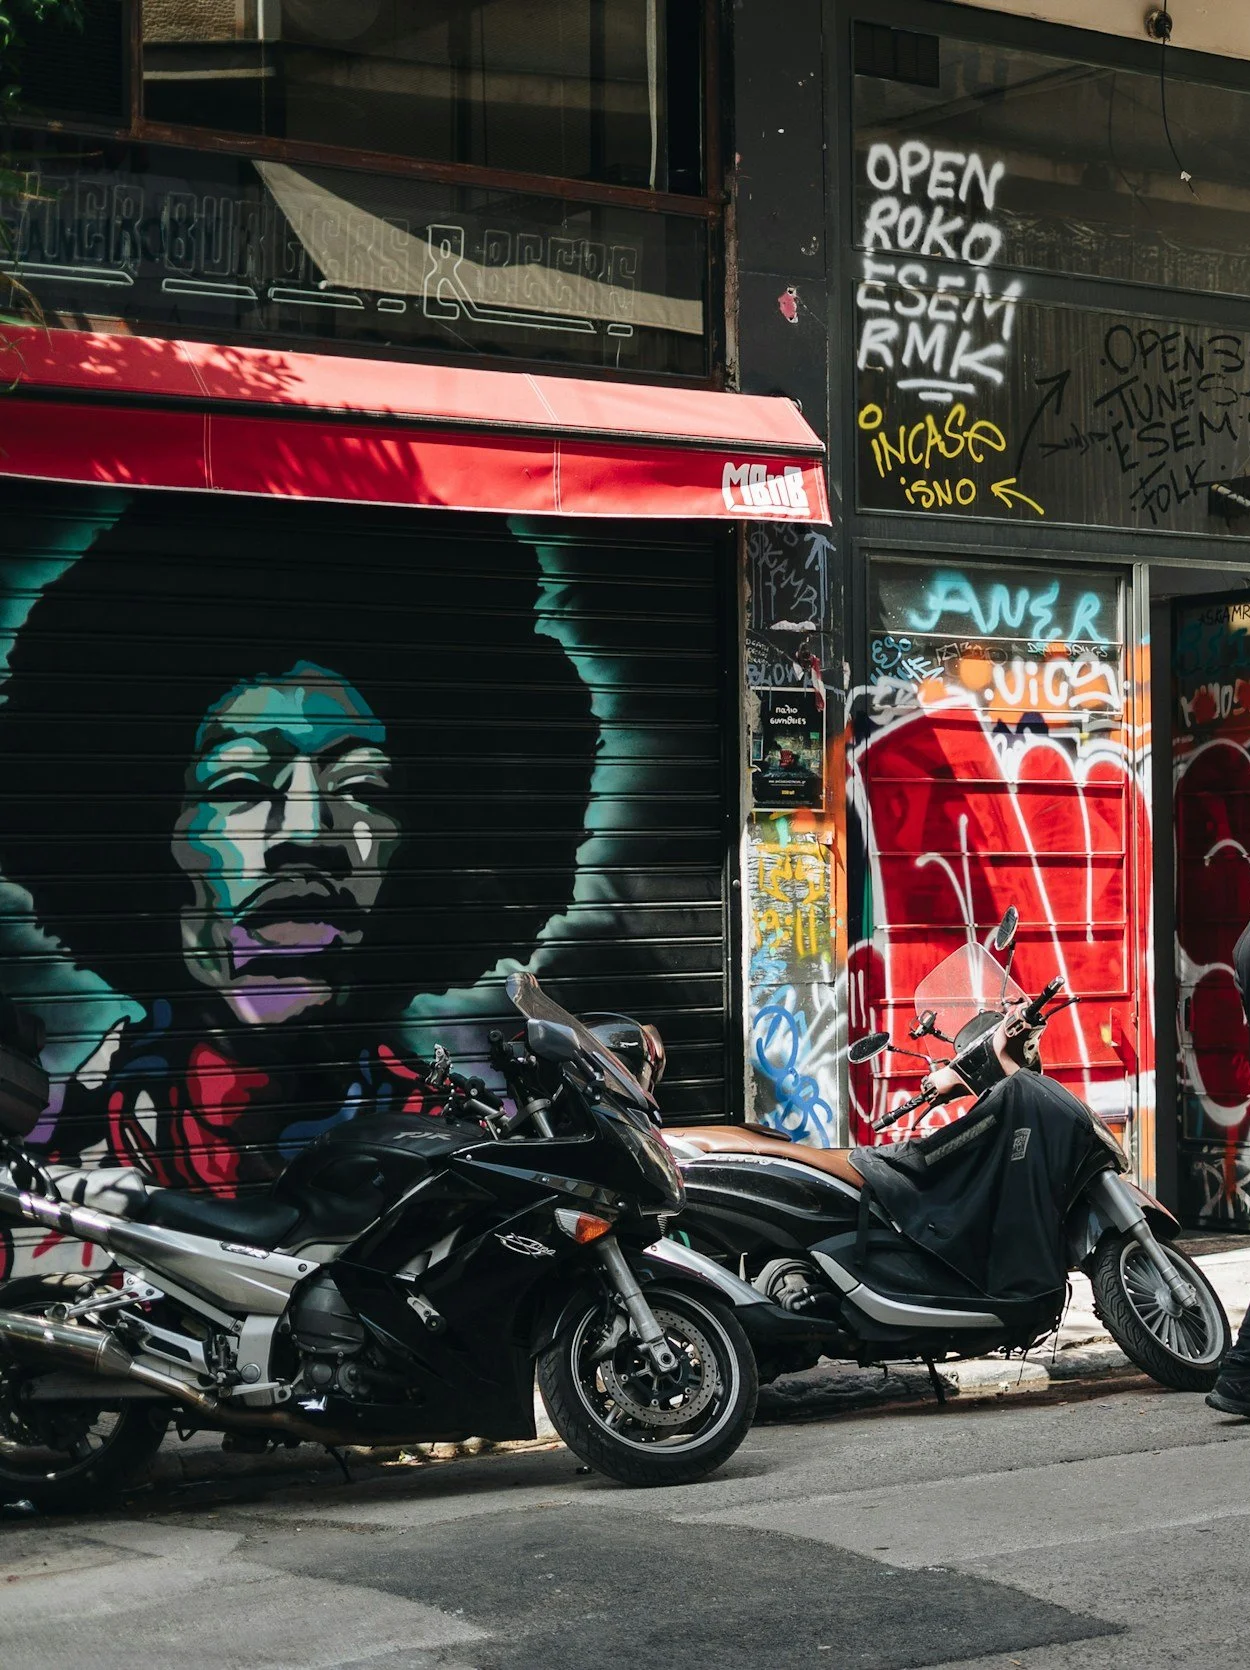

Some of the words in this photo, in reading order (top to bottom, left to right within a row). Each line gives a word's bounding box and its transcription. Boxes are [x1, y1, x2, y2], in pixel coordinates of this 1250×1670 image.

[867, 141, 1005, 211] OPEN
[863, 196, 1002, 268] ROKO
[857, 257, 1023, 341] ESEM
[857, 318, 1005, 384] RMK
